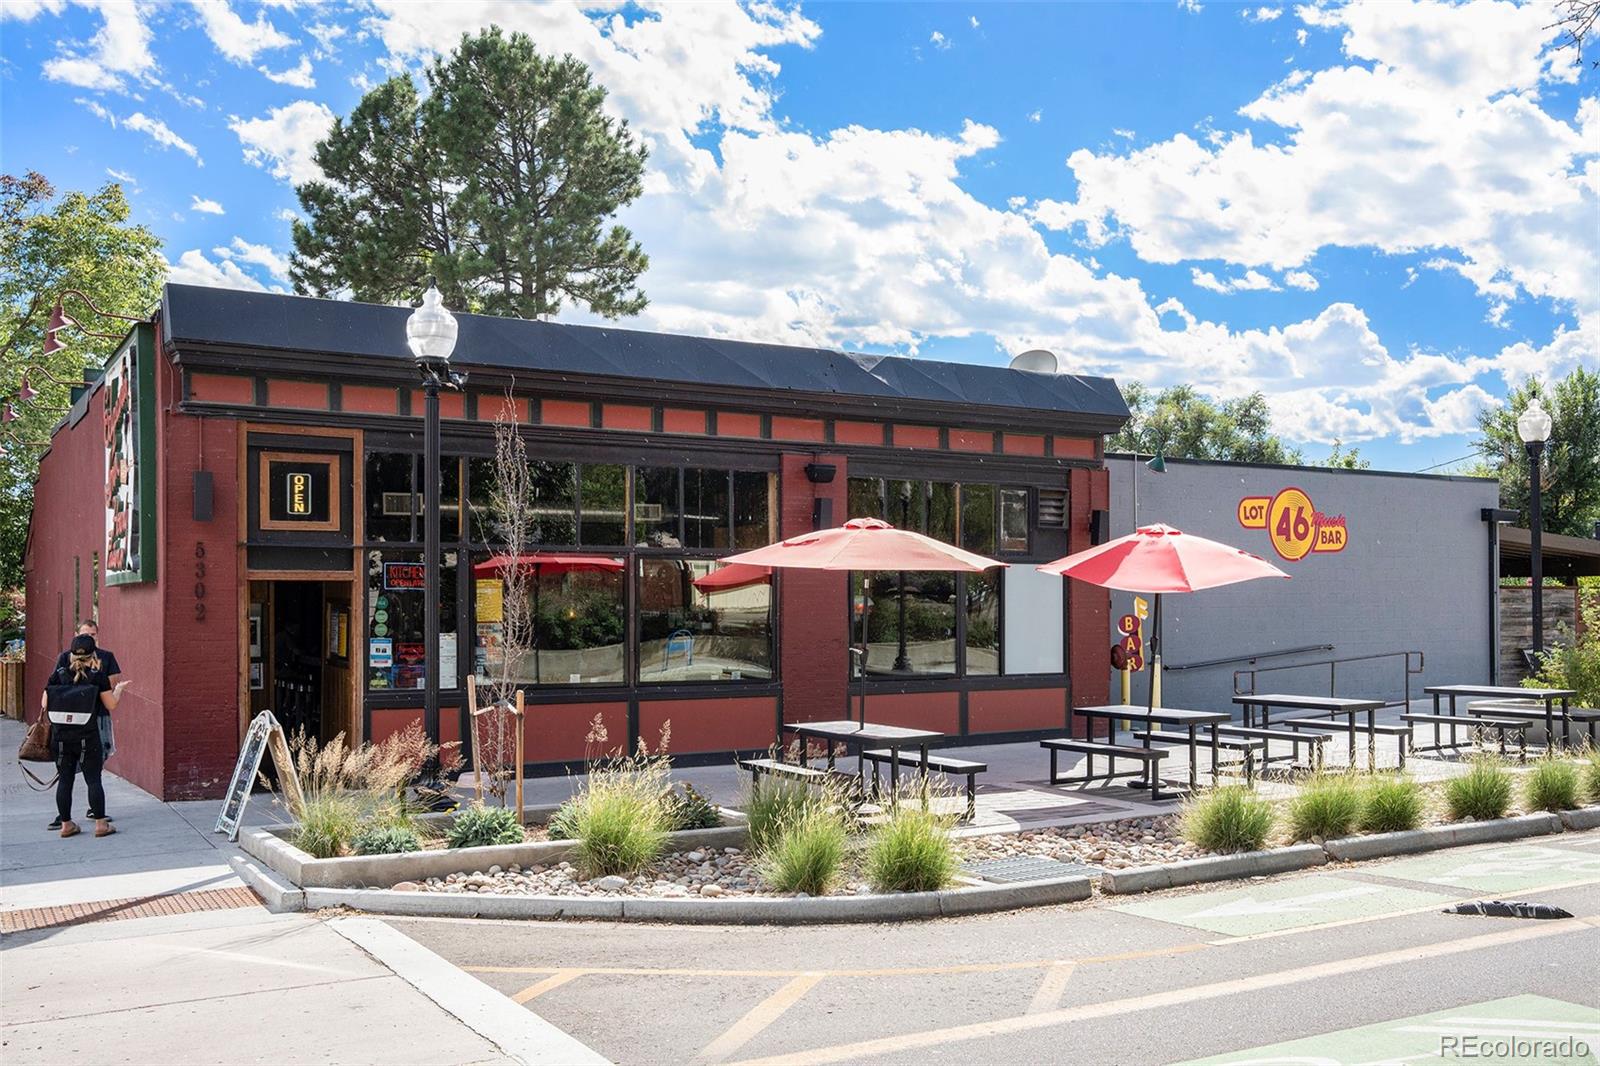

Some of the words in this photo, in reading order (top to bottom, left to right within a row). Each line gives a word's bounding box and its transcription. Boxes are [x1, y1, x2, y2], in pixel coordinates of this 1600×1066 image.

[294, 475, 304, 512] OPEN
[1243, 506, 1264, 520] LOT
[1276, 506, 1309, 541] 46
[1310, 511, 1346, 528] Music
[1321, 530, 1342, 544] BAR
[195, 541, 206, 622] 5302
[1124, 616, 1138, 671] BAR
